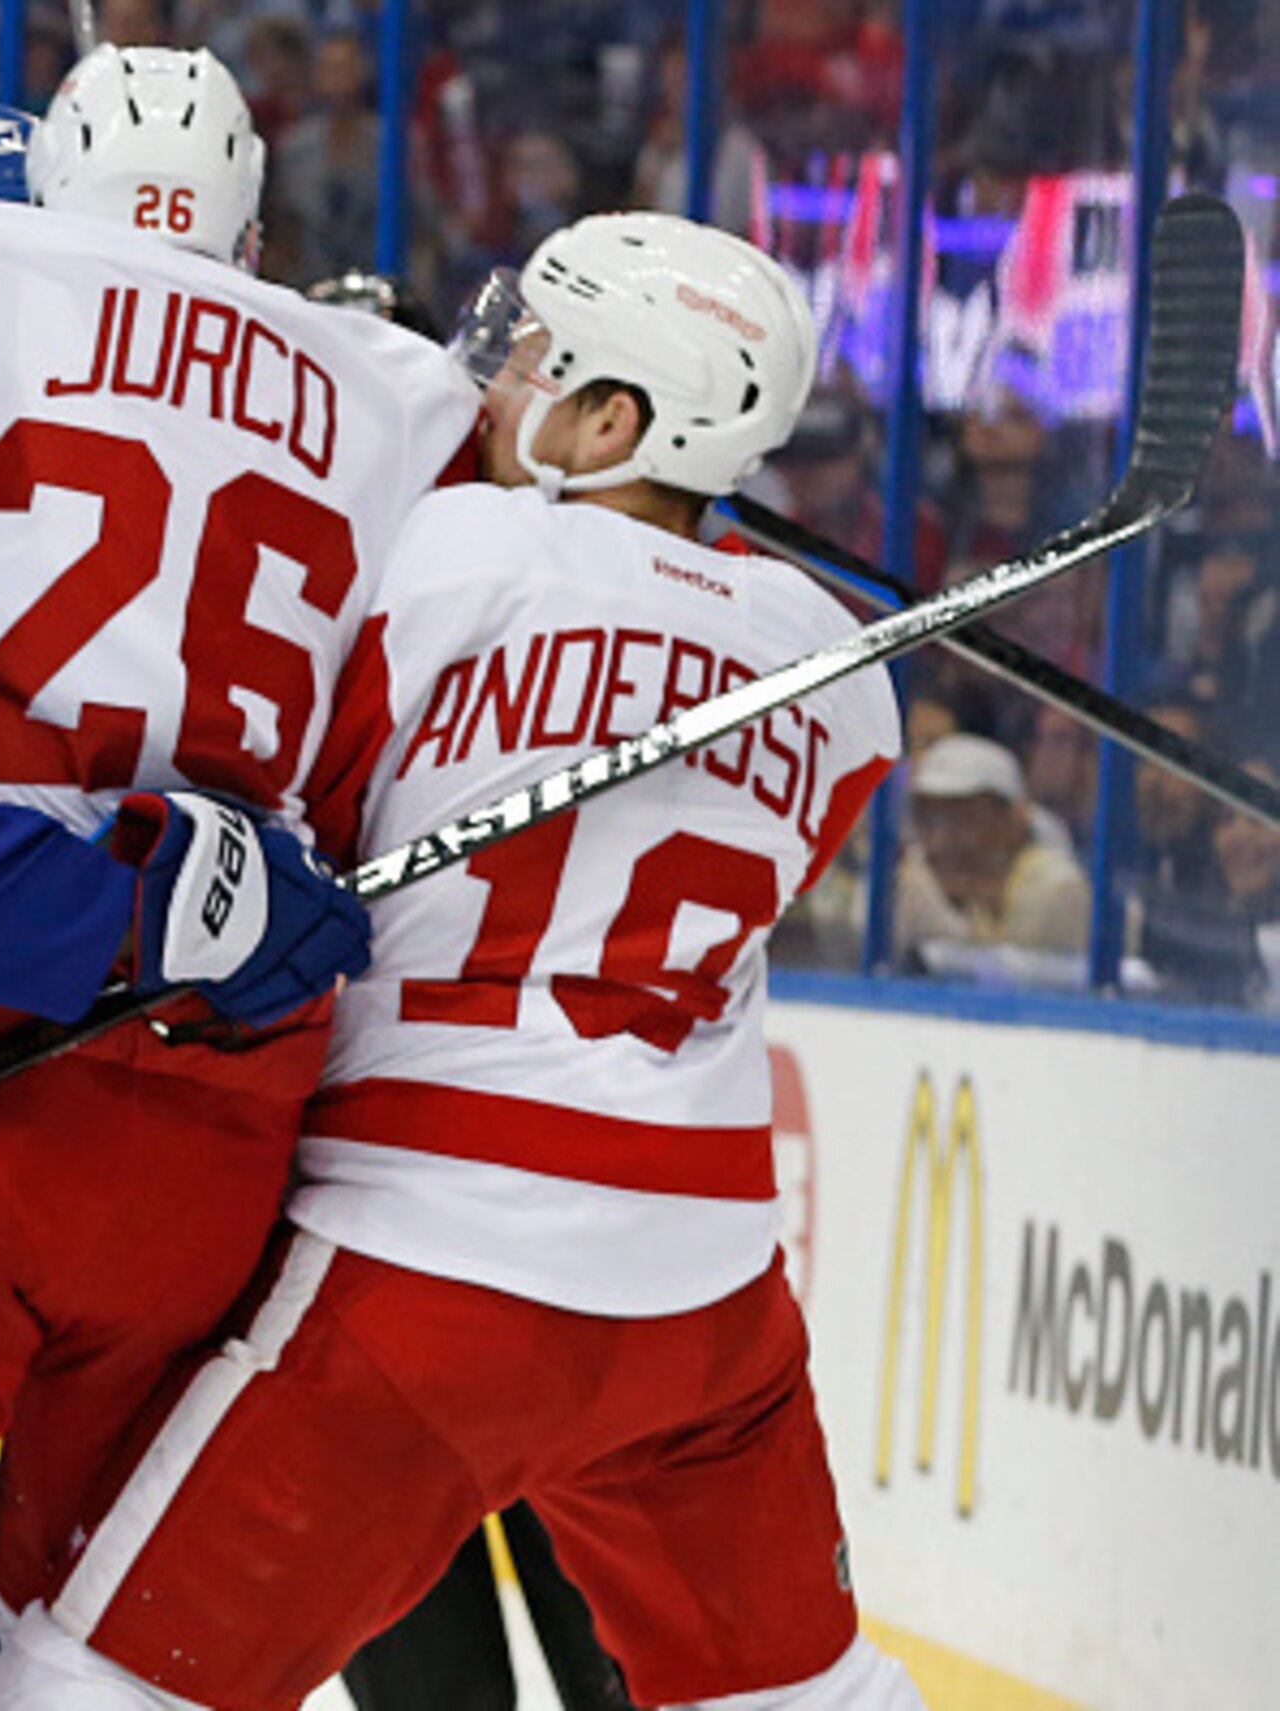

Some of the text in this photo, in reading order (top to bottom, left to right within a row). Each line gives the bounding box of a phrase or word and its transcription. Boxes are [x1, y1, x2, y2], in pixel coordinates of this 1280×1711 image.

[135, 184, 195, 232] 26
[45, 287, 337, 479] JURCO
[1007, 1217, 1280, 1484] McDonal
